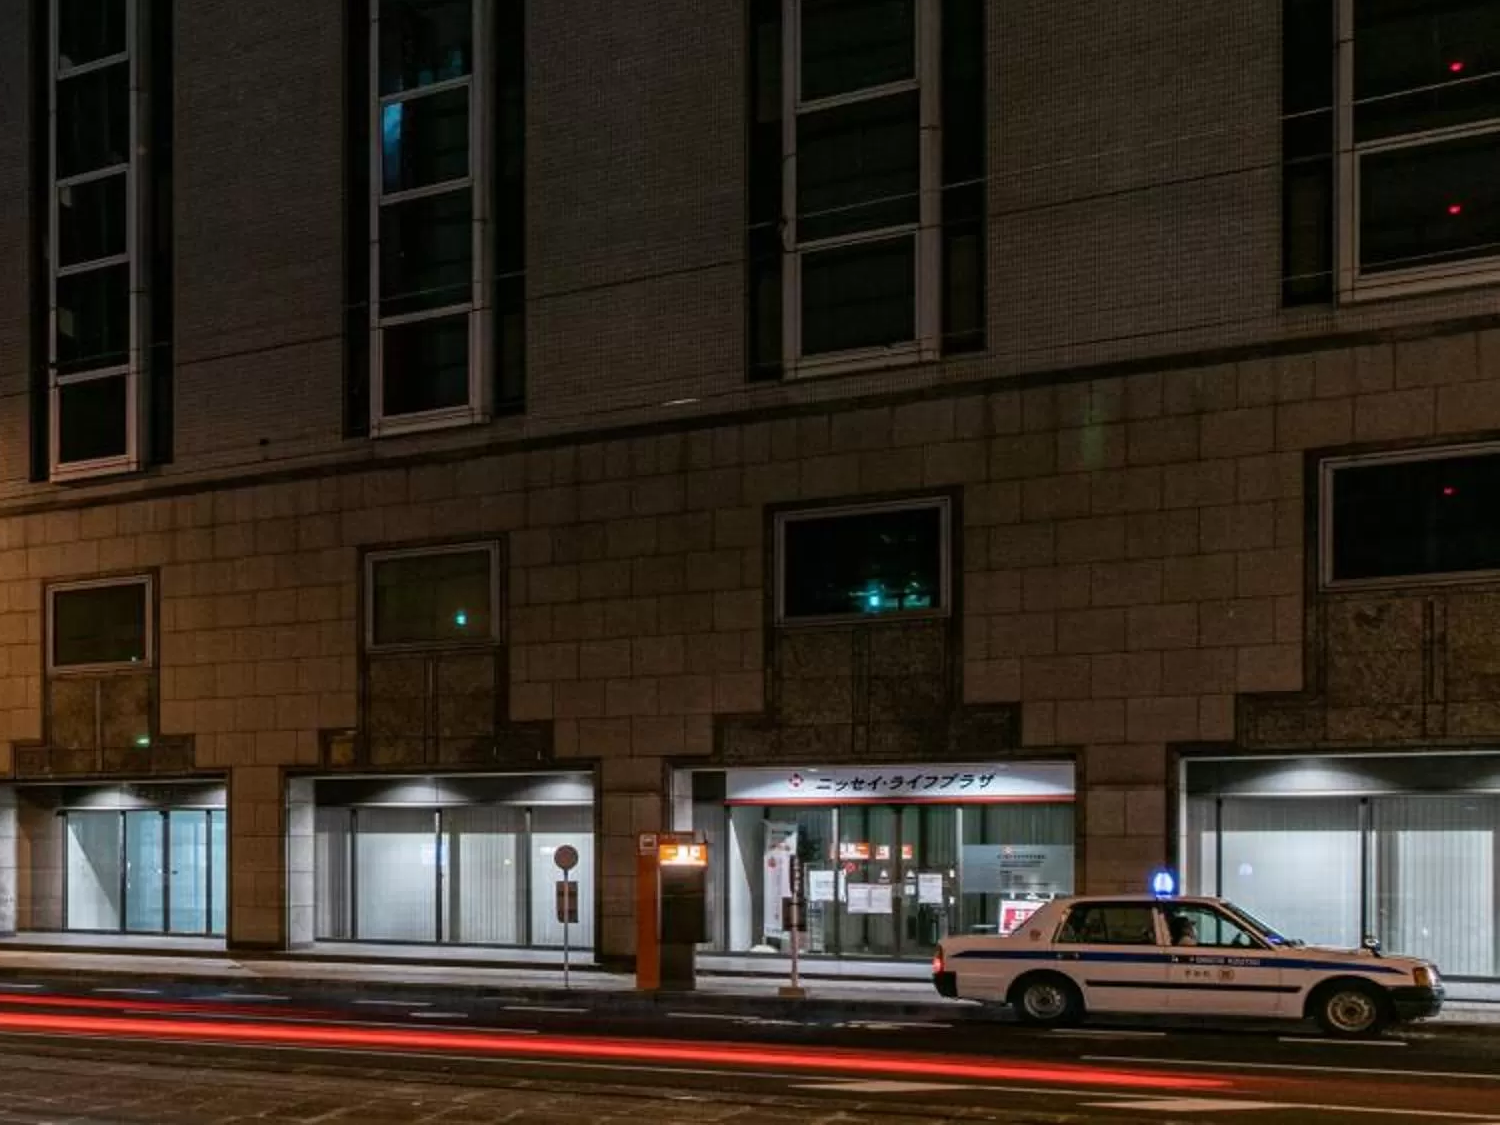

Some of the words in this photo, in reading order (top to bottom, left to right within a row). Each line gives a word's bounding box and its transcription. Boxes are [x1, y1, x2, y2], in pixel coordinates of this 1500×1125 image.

[815, 772, 997, 792] ニッセイ・ライフプラザ
